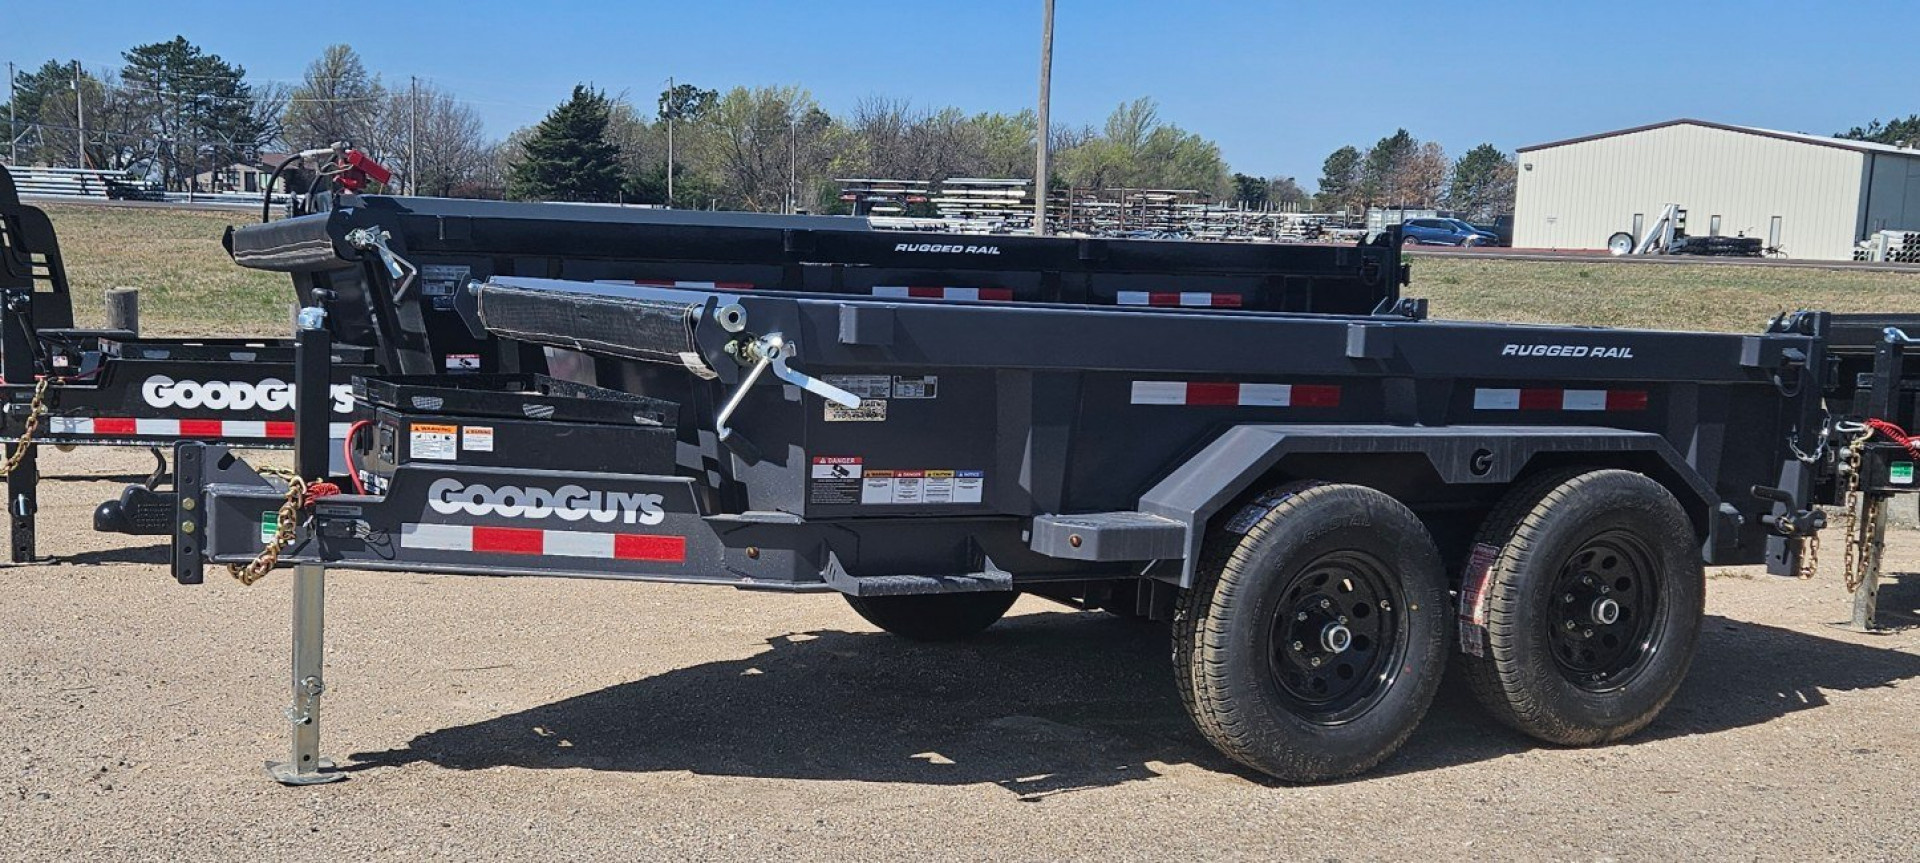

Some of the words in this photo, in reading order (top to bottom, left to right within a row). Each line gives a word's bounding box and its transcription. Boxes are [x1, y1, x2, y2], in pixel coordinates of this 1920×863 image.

[895, 243, 964, 253] RUGGED
[965, 245, 1001, 254] RAIL
[1502, 344, 1589, 357] RUGGED
[1590, 347, 1633, 358] RAIL
[142, 373, 354, 414] GOODGS
[828, 457, 855, 465] DANGER
[428, 477, 665, 525] GOODGUYS
